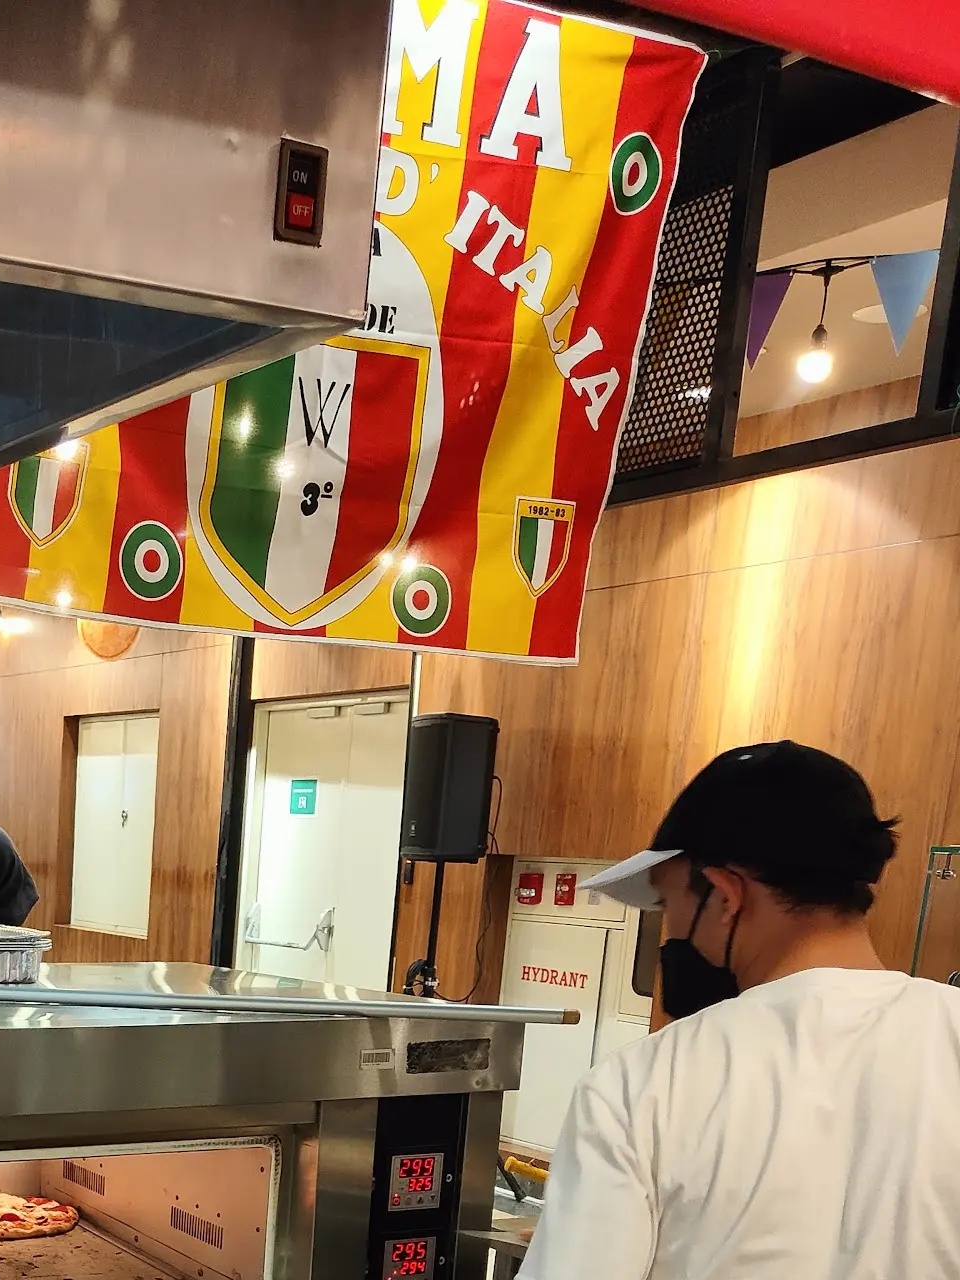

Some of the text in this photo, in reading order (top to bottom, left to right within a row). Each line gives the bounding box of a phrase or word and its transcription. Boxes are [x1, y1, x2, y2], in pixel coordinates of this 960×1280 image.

[292, 169, 308, 185] ON
[292, 204, 310, 216] OFF
[444, 190, 623, 431] ITALIA
[298, 376, 351, 449] W
[528, 505, 566, 518] 1982-83
[521, 966, 588, 989] HYDRANT
[399, 1157, 435, 1178] 299
[408, 1177, 433, 1192] 325
[392, 1241, 427, 1262] 295
[400, 1261, 426, 1275] 294
